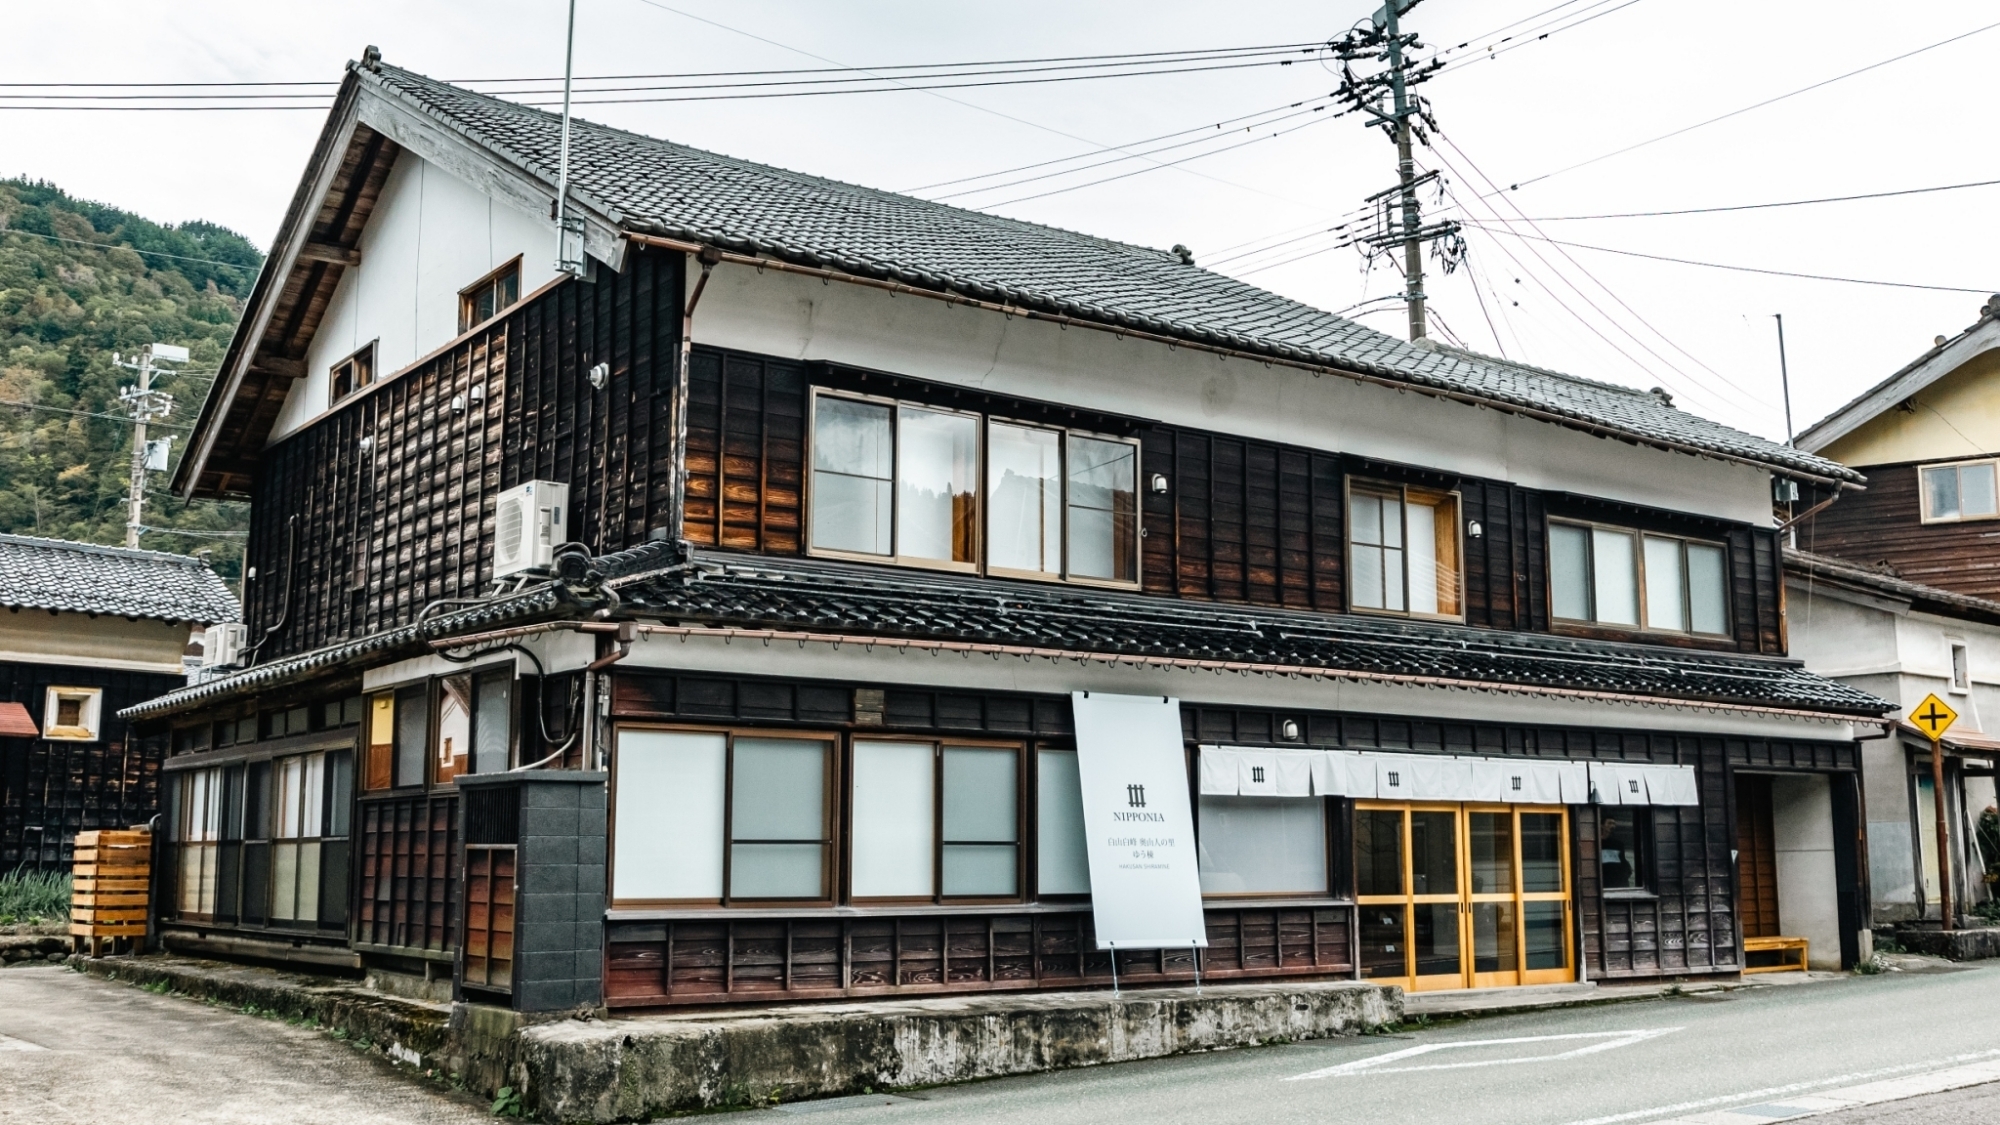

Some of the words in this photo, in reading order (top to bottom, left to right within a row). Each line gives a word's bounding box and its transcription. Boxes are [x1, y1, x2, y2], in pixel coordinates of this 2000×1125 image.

[1113, 812, 1165, 822] NIPPONIA
[1107, 837, 1137, 847] 白山白峰
[1139, 837, 1175, 847] 奥山人の里
